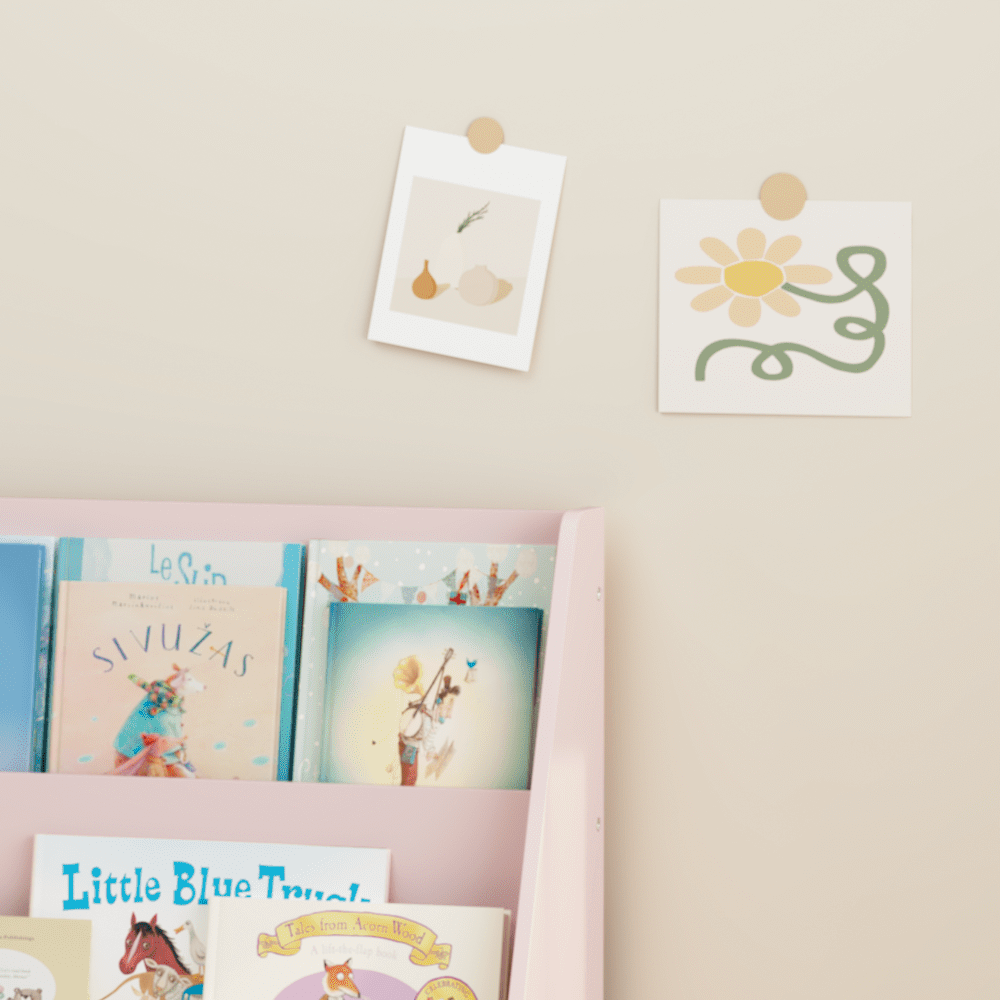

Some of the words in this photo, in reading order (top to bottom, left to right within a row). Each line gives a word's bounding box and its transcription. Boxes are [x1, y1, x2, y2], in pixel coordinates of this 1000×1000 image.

[92, 622, 254, 678] SIVUŽAS
[62, 862, 161, 911] Little
[172, 860, 252, 905] Blue
[285, 921, 316, 938] Tales
[319, 917, 348, 932] from
[352, 917, 388, 934] Acorn
[392, 919, 427, 946] Wood
